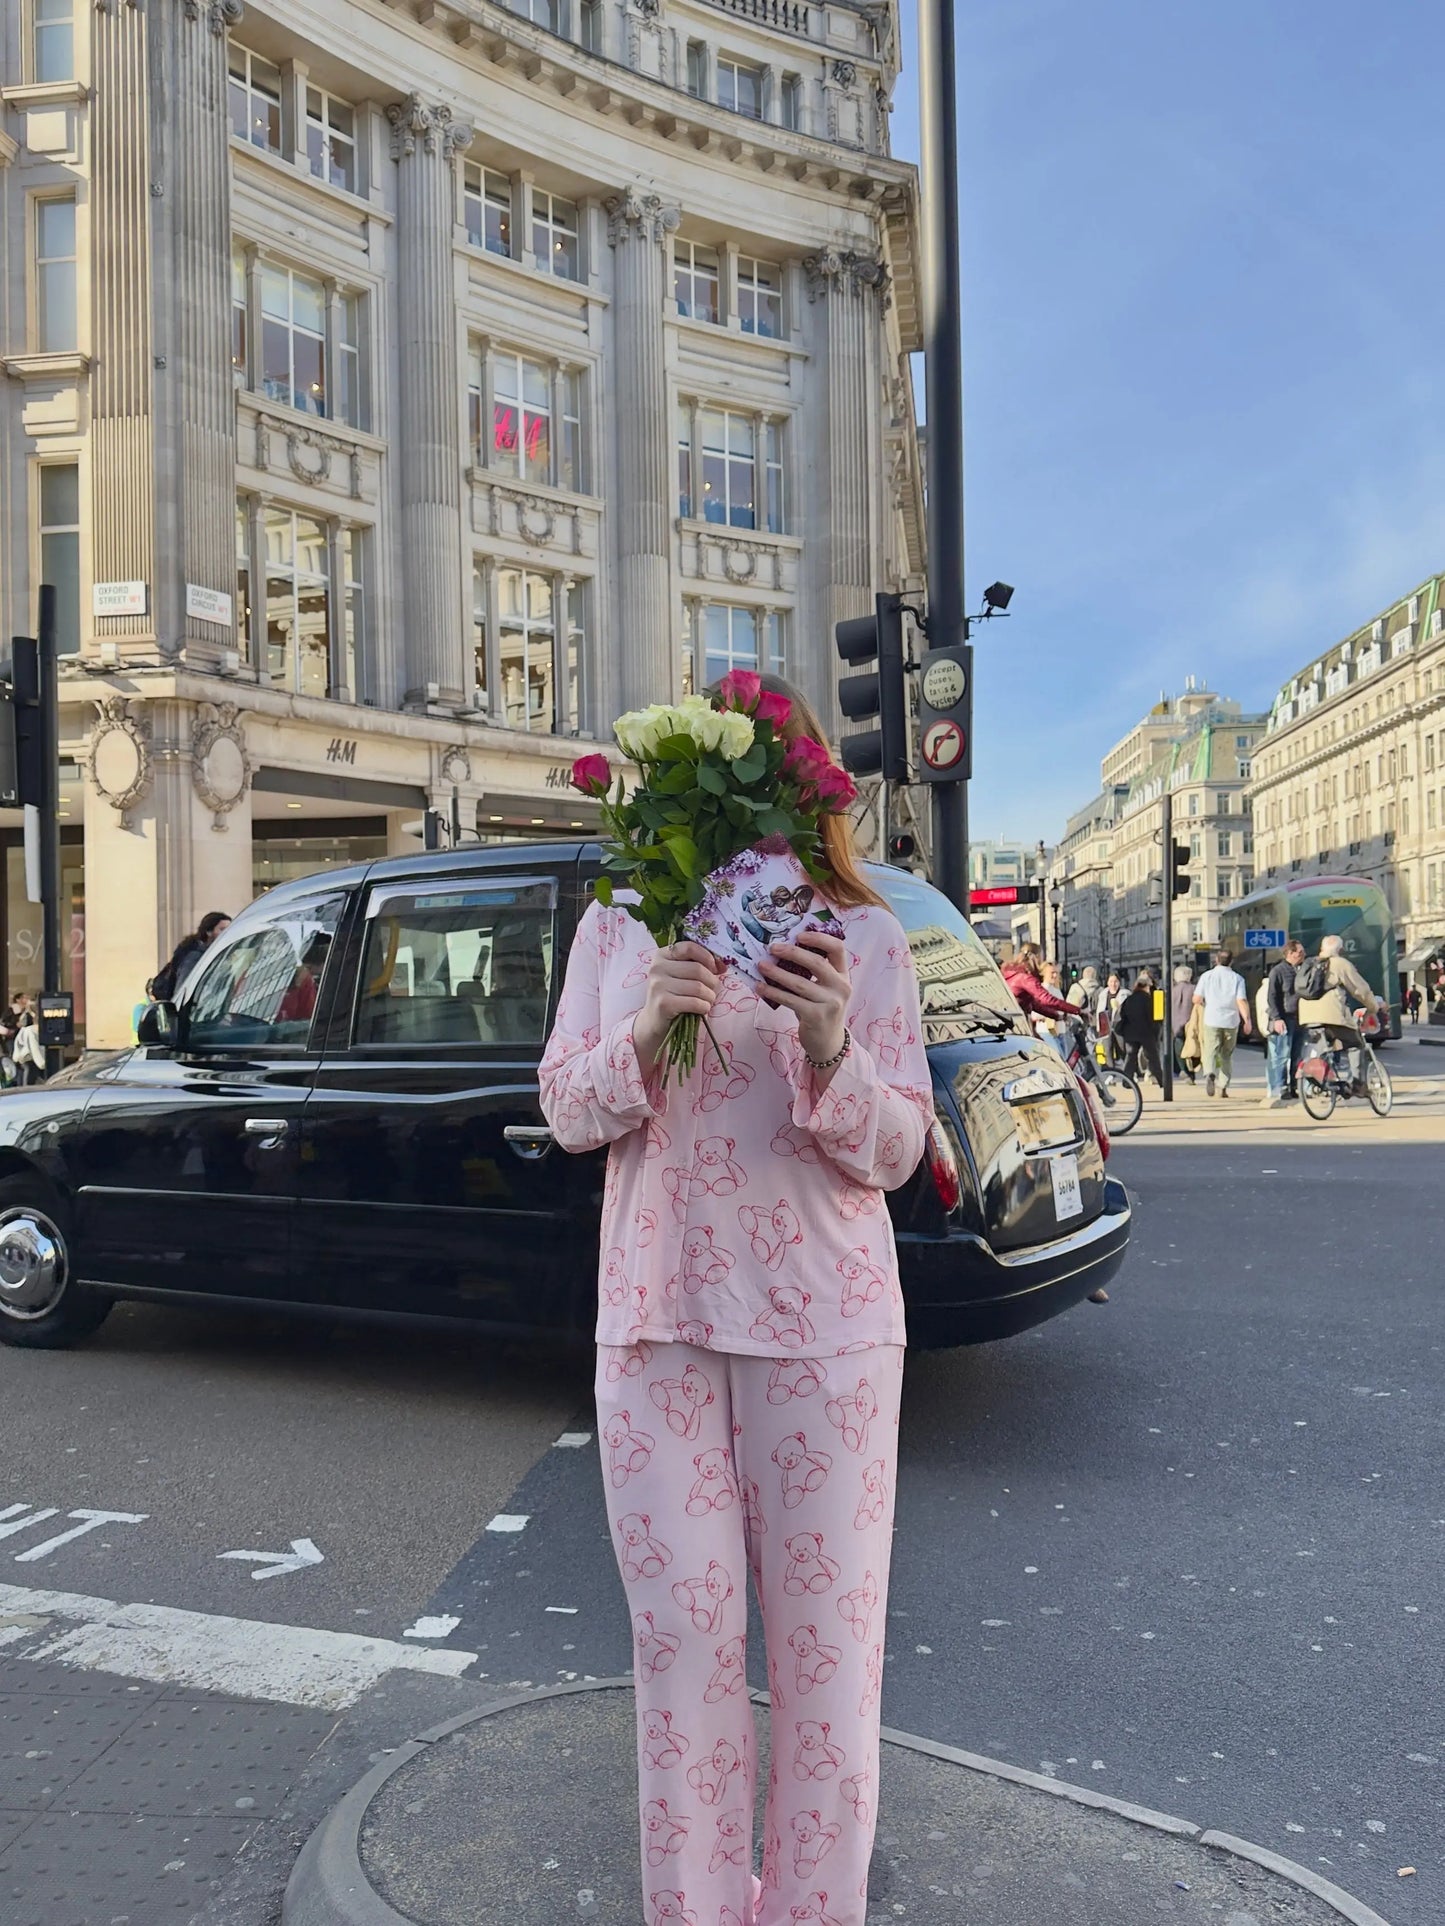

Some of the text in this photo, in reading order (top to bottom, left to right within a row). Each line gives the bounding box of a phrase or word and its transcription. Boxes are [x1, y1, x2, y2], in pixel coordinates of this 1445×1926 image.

[98, 586, 129, 595] OXFORD
[191, 588, 218, 602] OXFORD
[99, 596, 127, 605] STREET
[191, 598, 216, 612] CIRCUS
[326, 738, 357, 765] H&M
[545, 767, 571, 790] H&M
